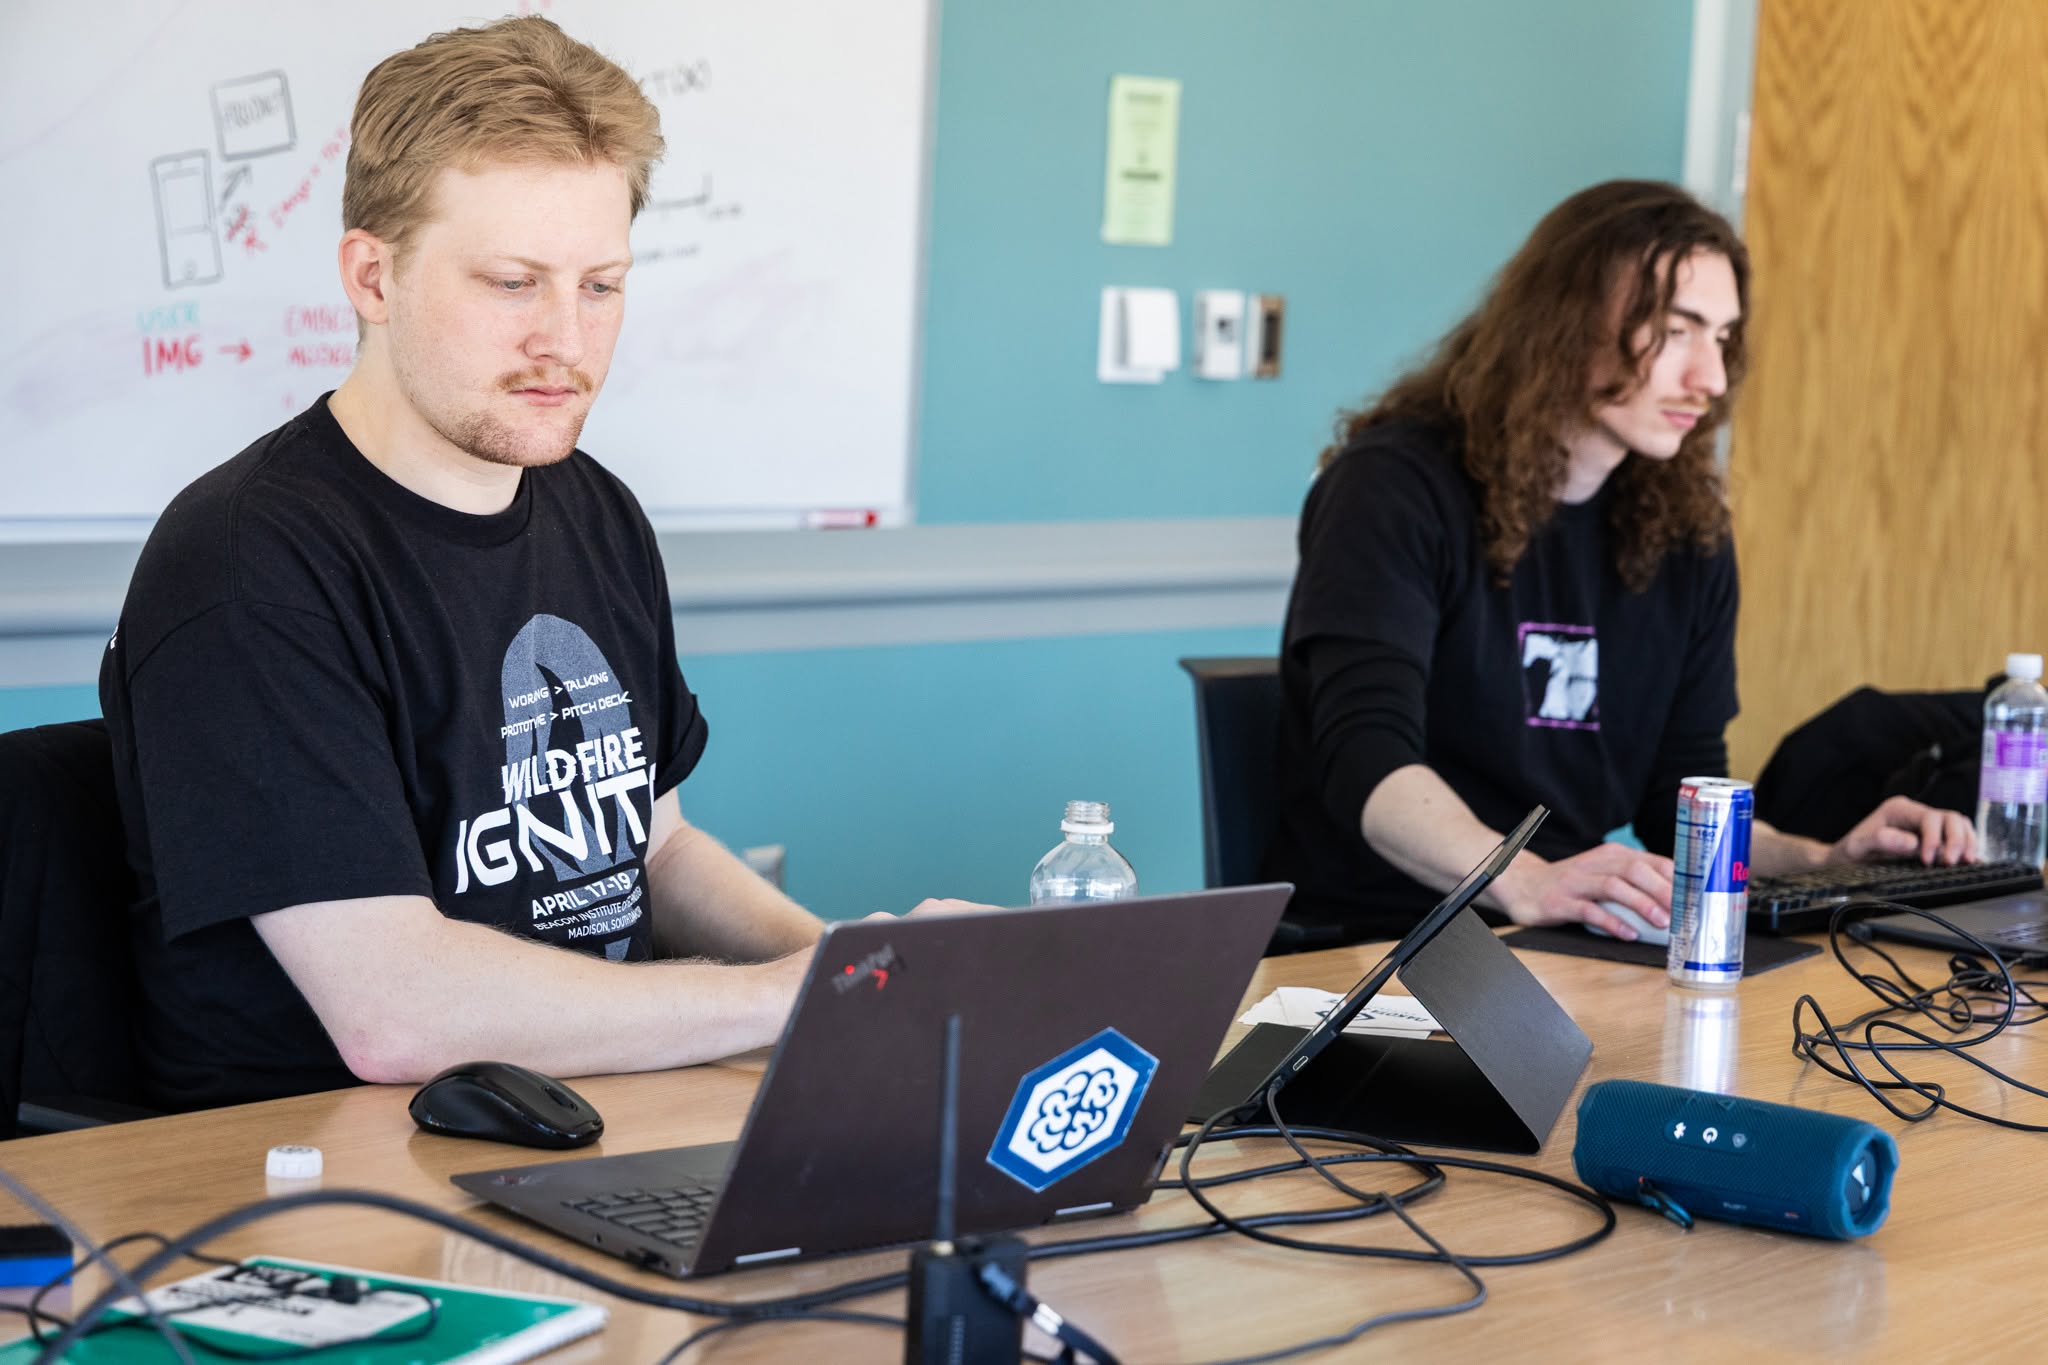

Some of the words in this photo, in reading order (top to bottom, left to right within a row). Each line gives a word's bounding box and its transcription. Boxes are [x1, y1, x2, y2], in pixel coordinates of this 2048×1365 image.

[142, 333, 203, 377] IMG
[562, 671, 608, 692] TALKING
[501, 713, 546, 739] PROTOTYE
[561, 700, 597, 720] PITCH
[598, 690, 632, 710] DECK
[455, 763, 657, 894] IGNIT
[531, 889, 588, 919] APRIL
[584, 872, 631, 897] 17-19
[533, 915, 580, 930] BEACOM
[578, 901, 622, 921] INSTITUTE
[568, 921, 610, 939] MADISON,
